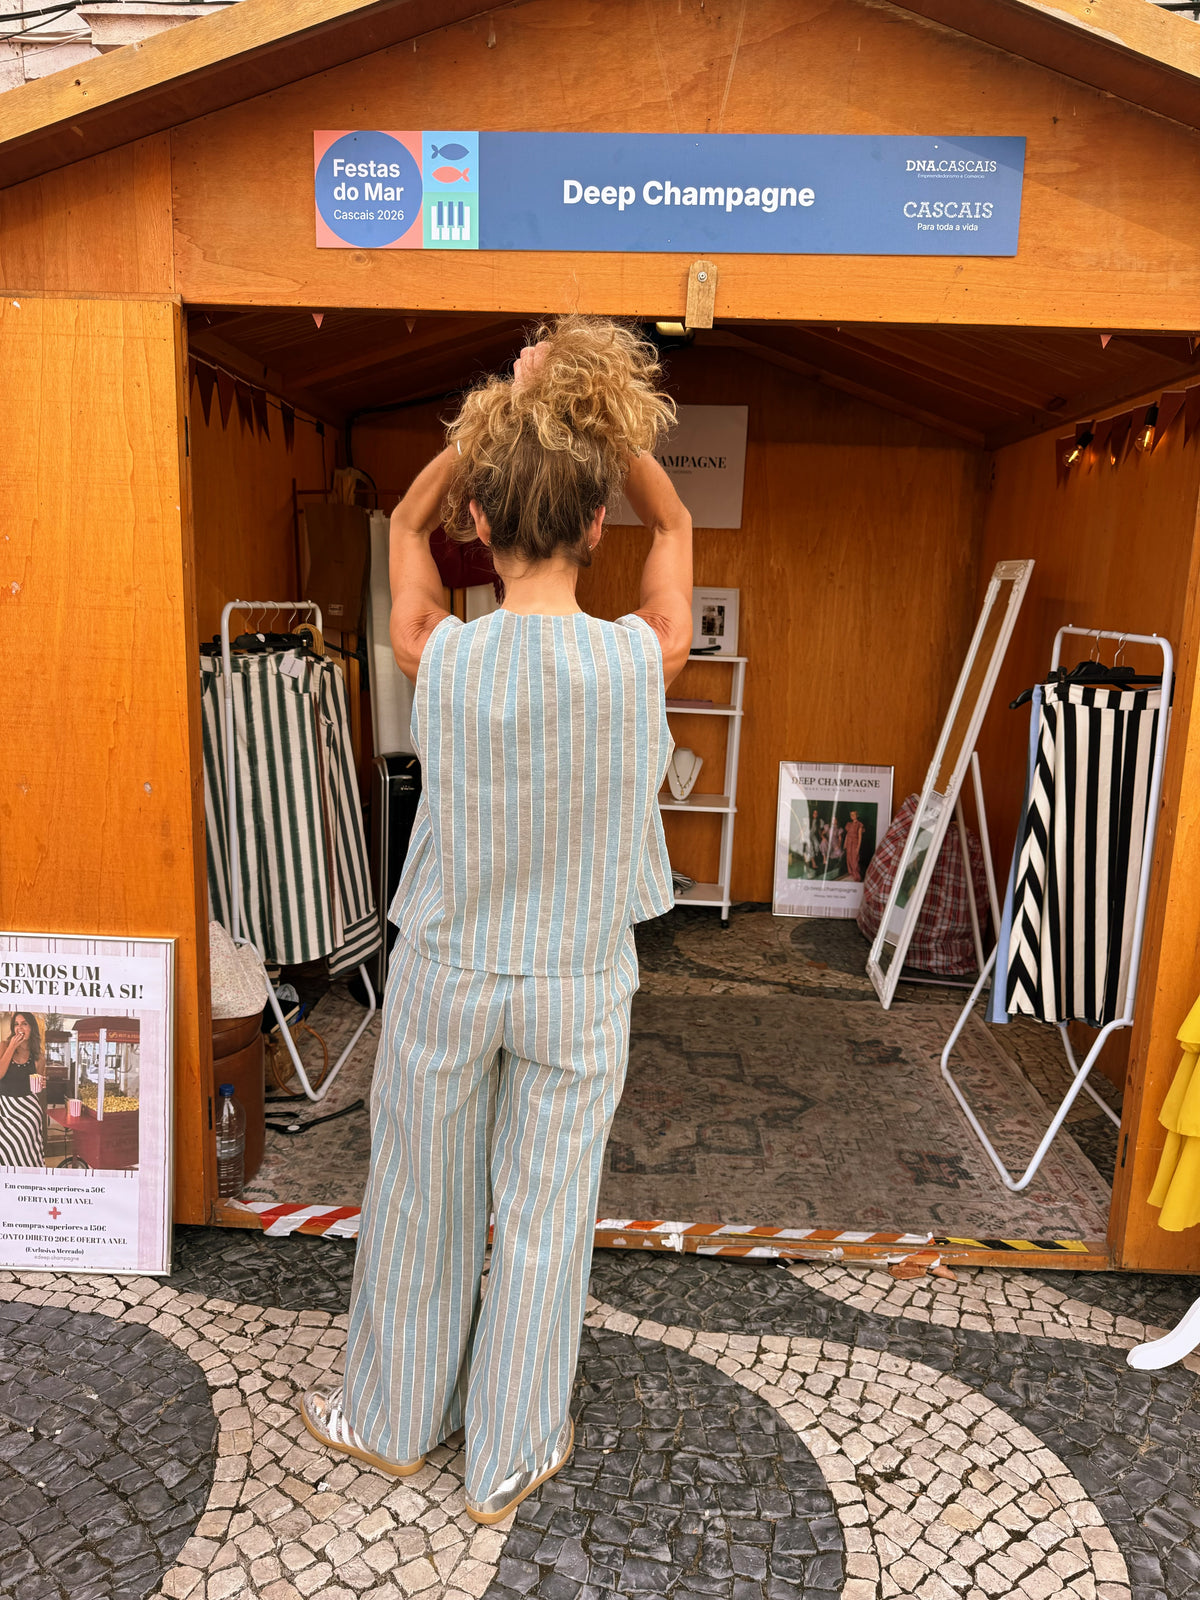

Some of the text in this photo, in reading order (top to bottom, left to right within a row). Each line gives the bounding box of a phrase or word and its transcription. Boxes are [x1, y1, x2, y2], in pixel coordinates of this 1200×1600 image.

[333, 158, 401, 178] Festas
[905, 159, 997, 172] DNA.CASCAIS
[333, 182, 404, 201] do Mar
[563, 179, 816, 213] Deep Champagne
[333, 209, 405, 221] Cascais 2026
[903, 201, 994, 219] CASCAIS
[917, 222, 935, 231] Para
[936, 223, 954, 231] toda
[962, 223, 979, 231] vida
[653, 455, 727, 469] AMPAGNE
[791, 776, 881, 788] DEEP CHAMPAGNE
[1, 962, 100, 981] TEMOS UM
[0, 979, 143, 999] SENTE PARA SI!
[4, 1182, 16, 1190] Em
[17, 1184, 46, 1192] compras
[47, 1185, 85, 1193] superiores
[17, 1195, 48, 1204] OFERTA
[45, 1224, 83, 1232] superiores
[25, 1234, 54, 1242] DIRETO
[76, 1236, 106, 1244] OFERTA
[108, 1237, 128, 1245] ANEL
